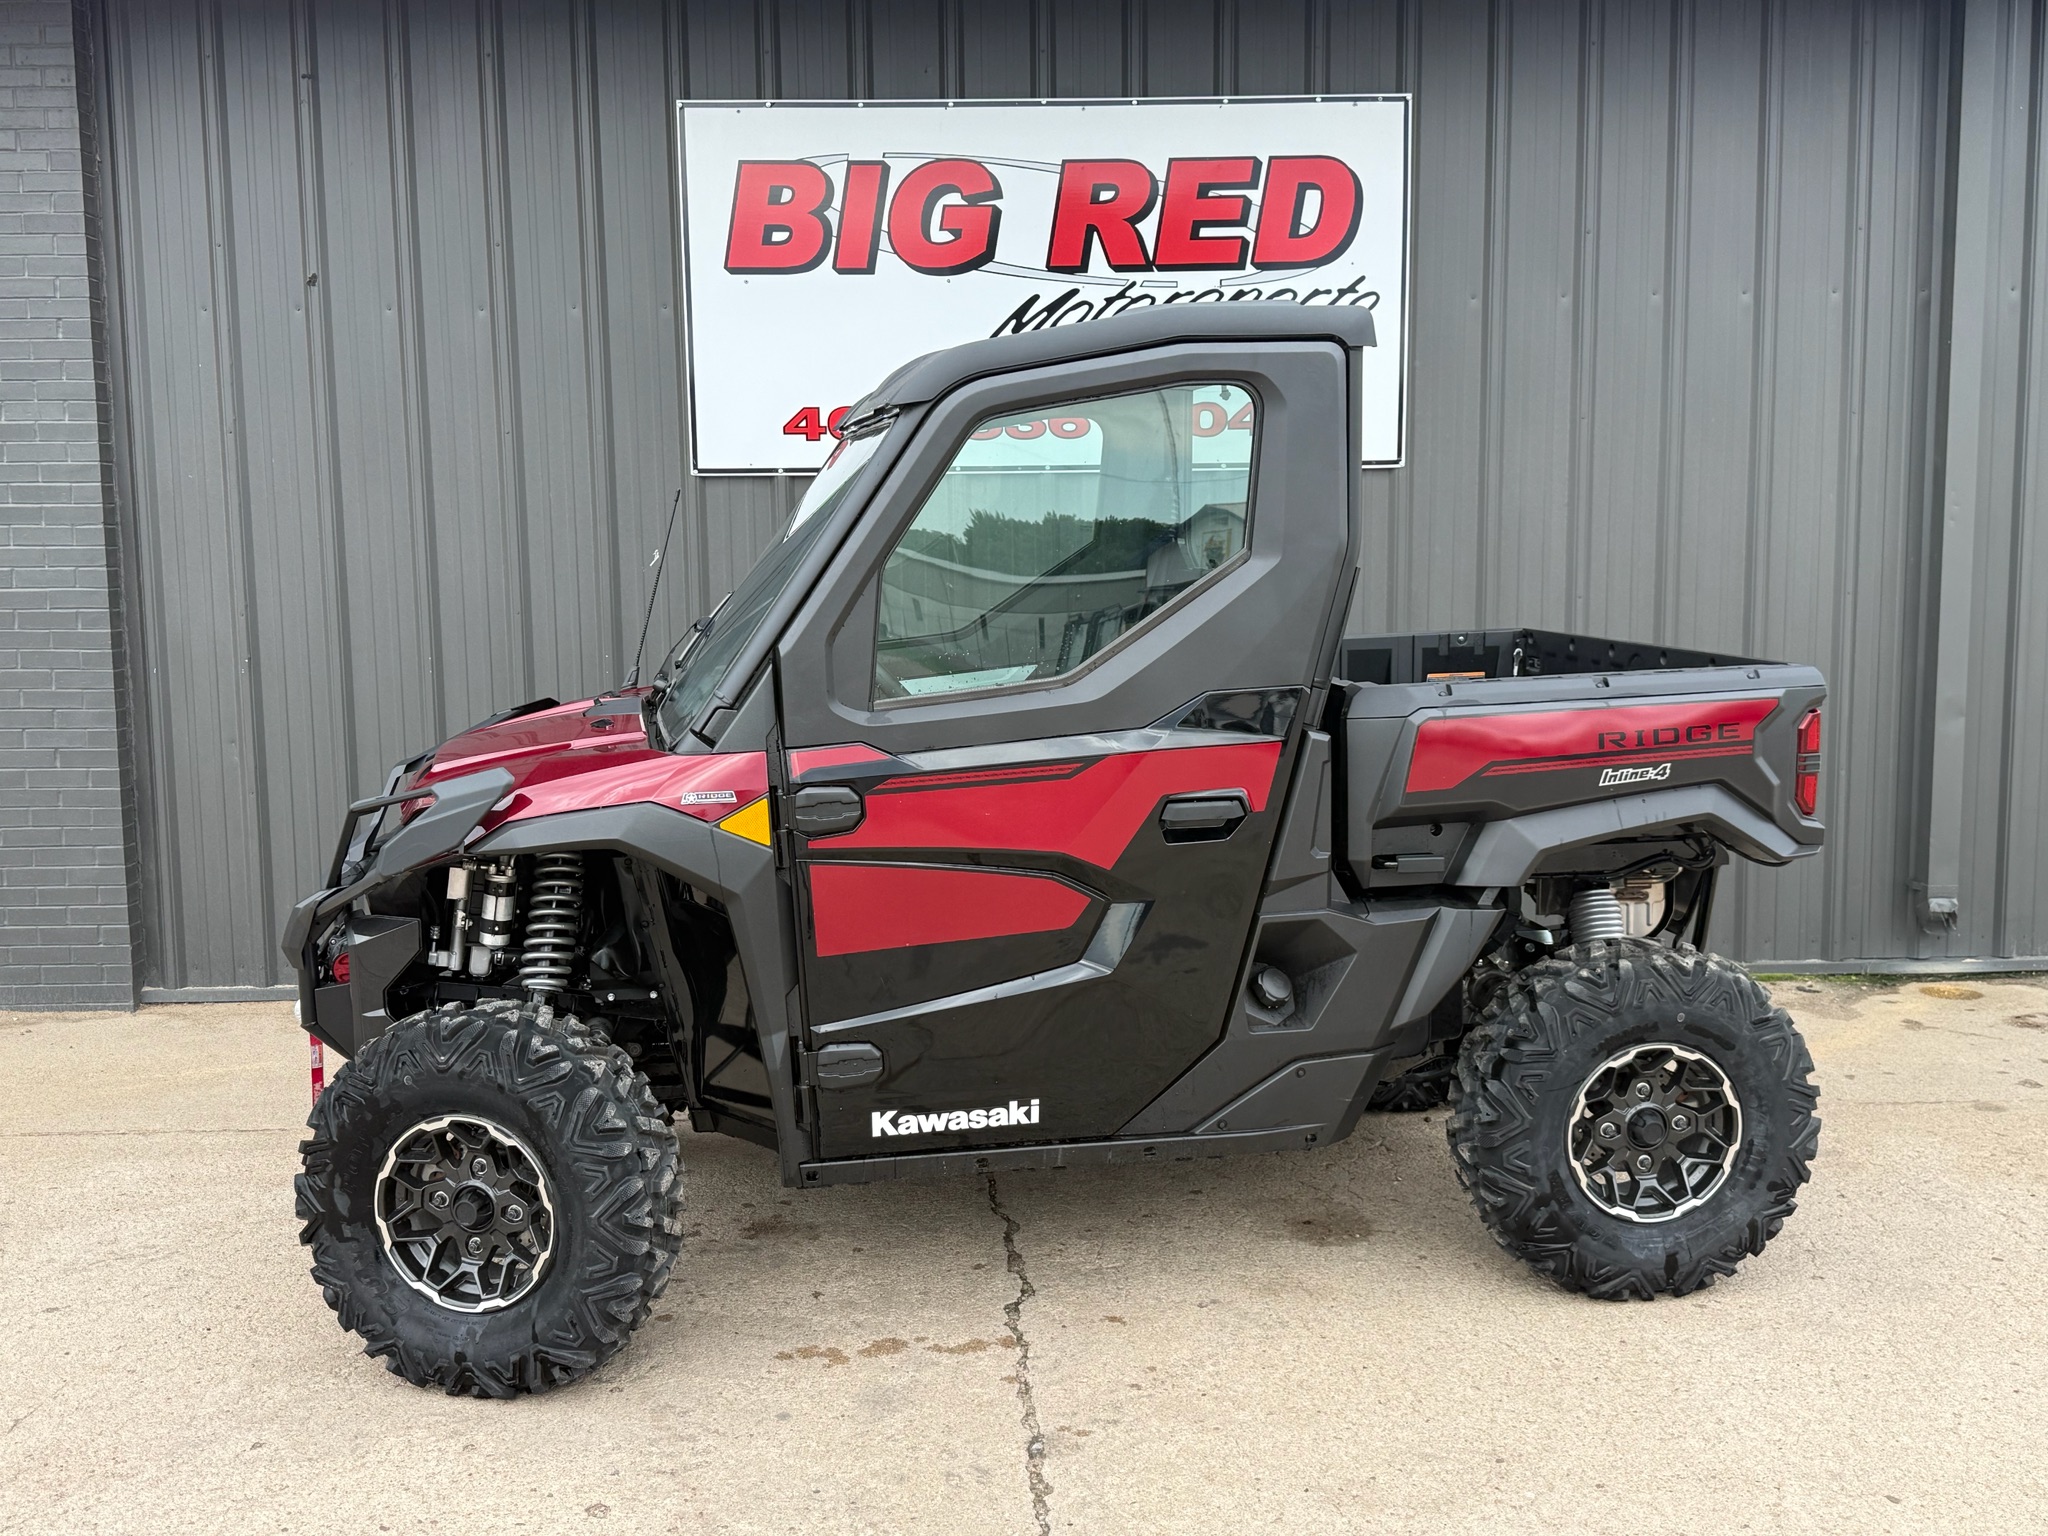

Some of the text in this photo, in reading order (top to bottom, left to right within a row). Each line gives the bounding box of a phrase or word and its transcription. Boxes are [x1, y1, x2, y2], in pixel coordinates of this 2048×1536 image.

[724, 155, 1364, 276] BIG RED
[1598, 723, 1740, 750] RIDGE
[1599, 763, 1671, 786] Inline-4
[871, 1099, 1040, 1138] Kawasaki
